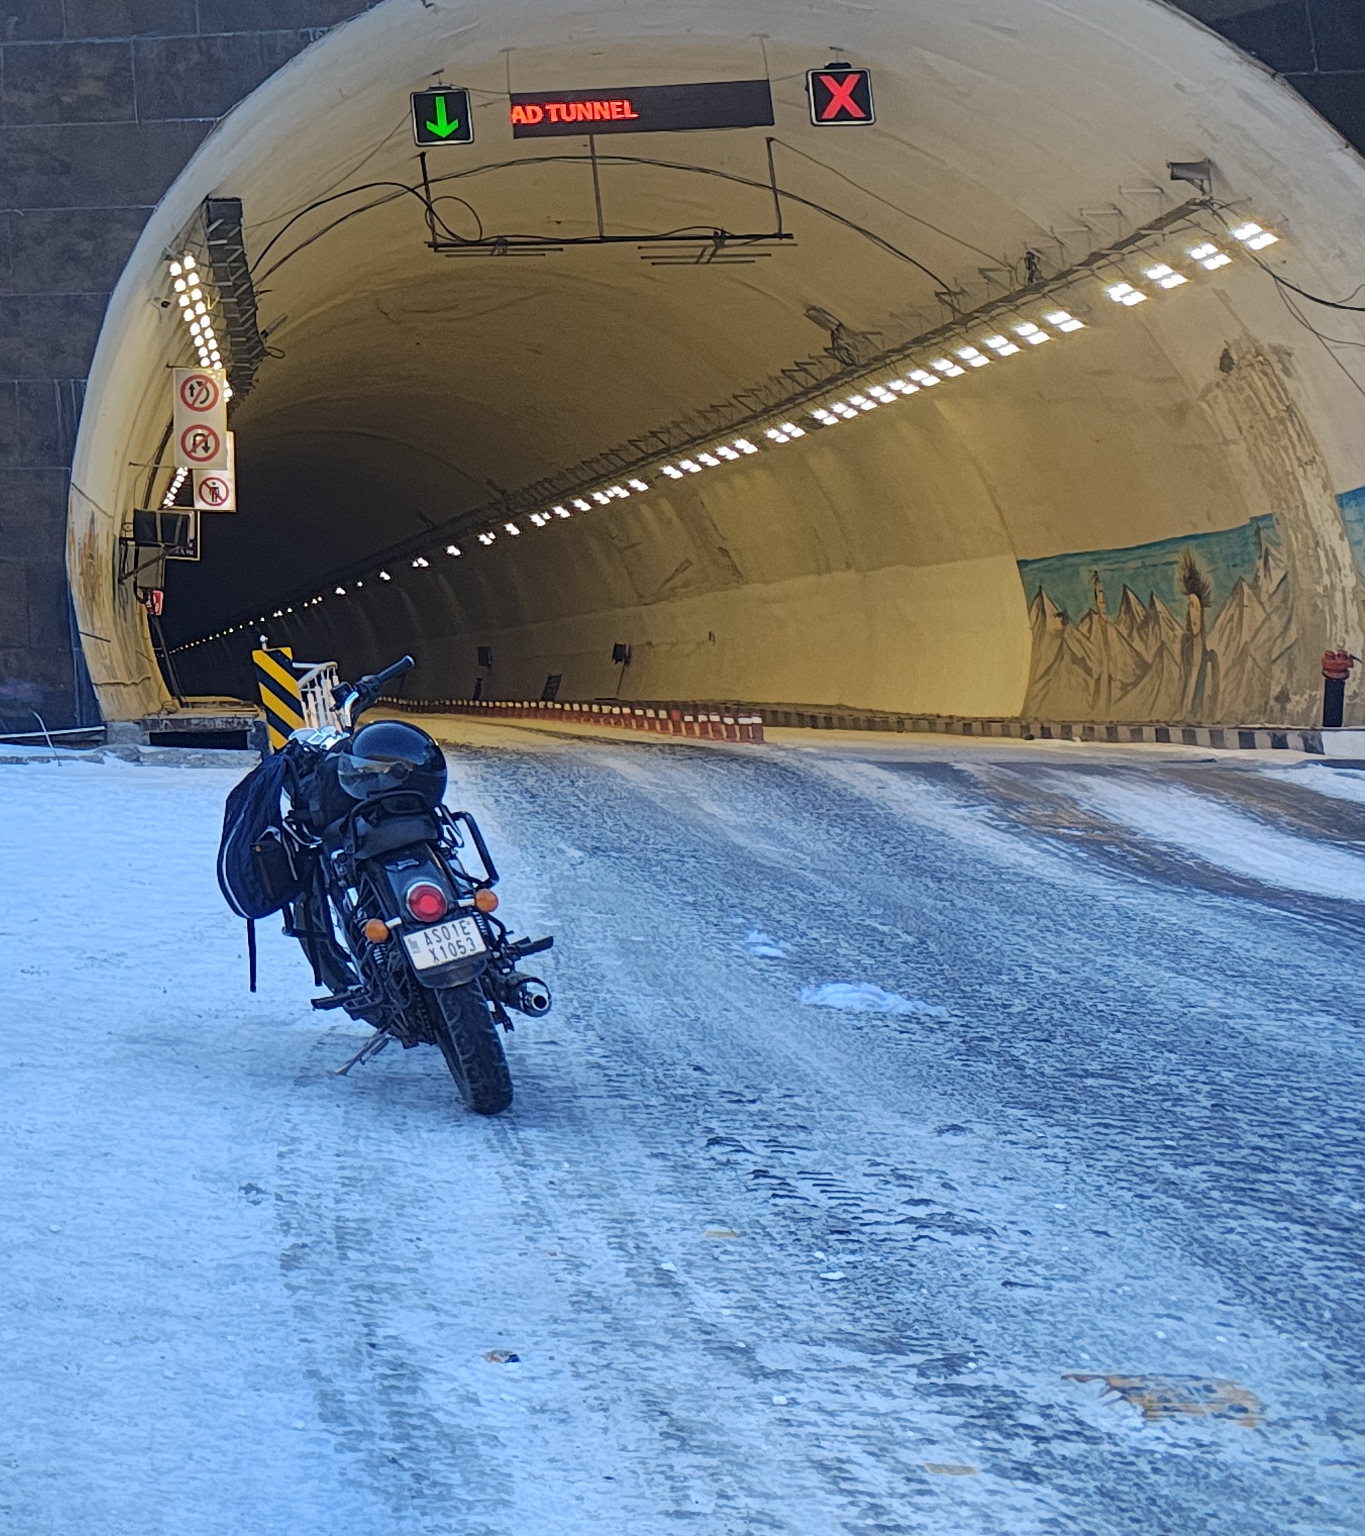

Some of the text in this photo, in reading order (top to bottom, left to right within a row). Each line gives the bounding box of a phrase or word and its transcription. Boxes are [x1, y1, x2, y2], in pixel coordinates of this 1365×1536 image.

[511, 99, 640, 124] AD TUNNEL
[423, 920, 471, 946] AS01E
[428, 936, 477, 963] X1053
